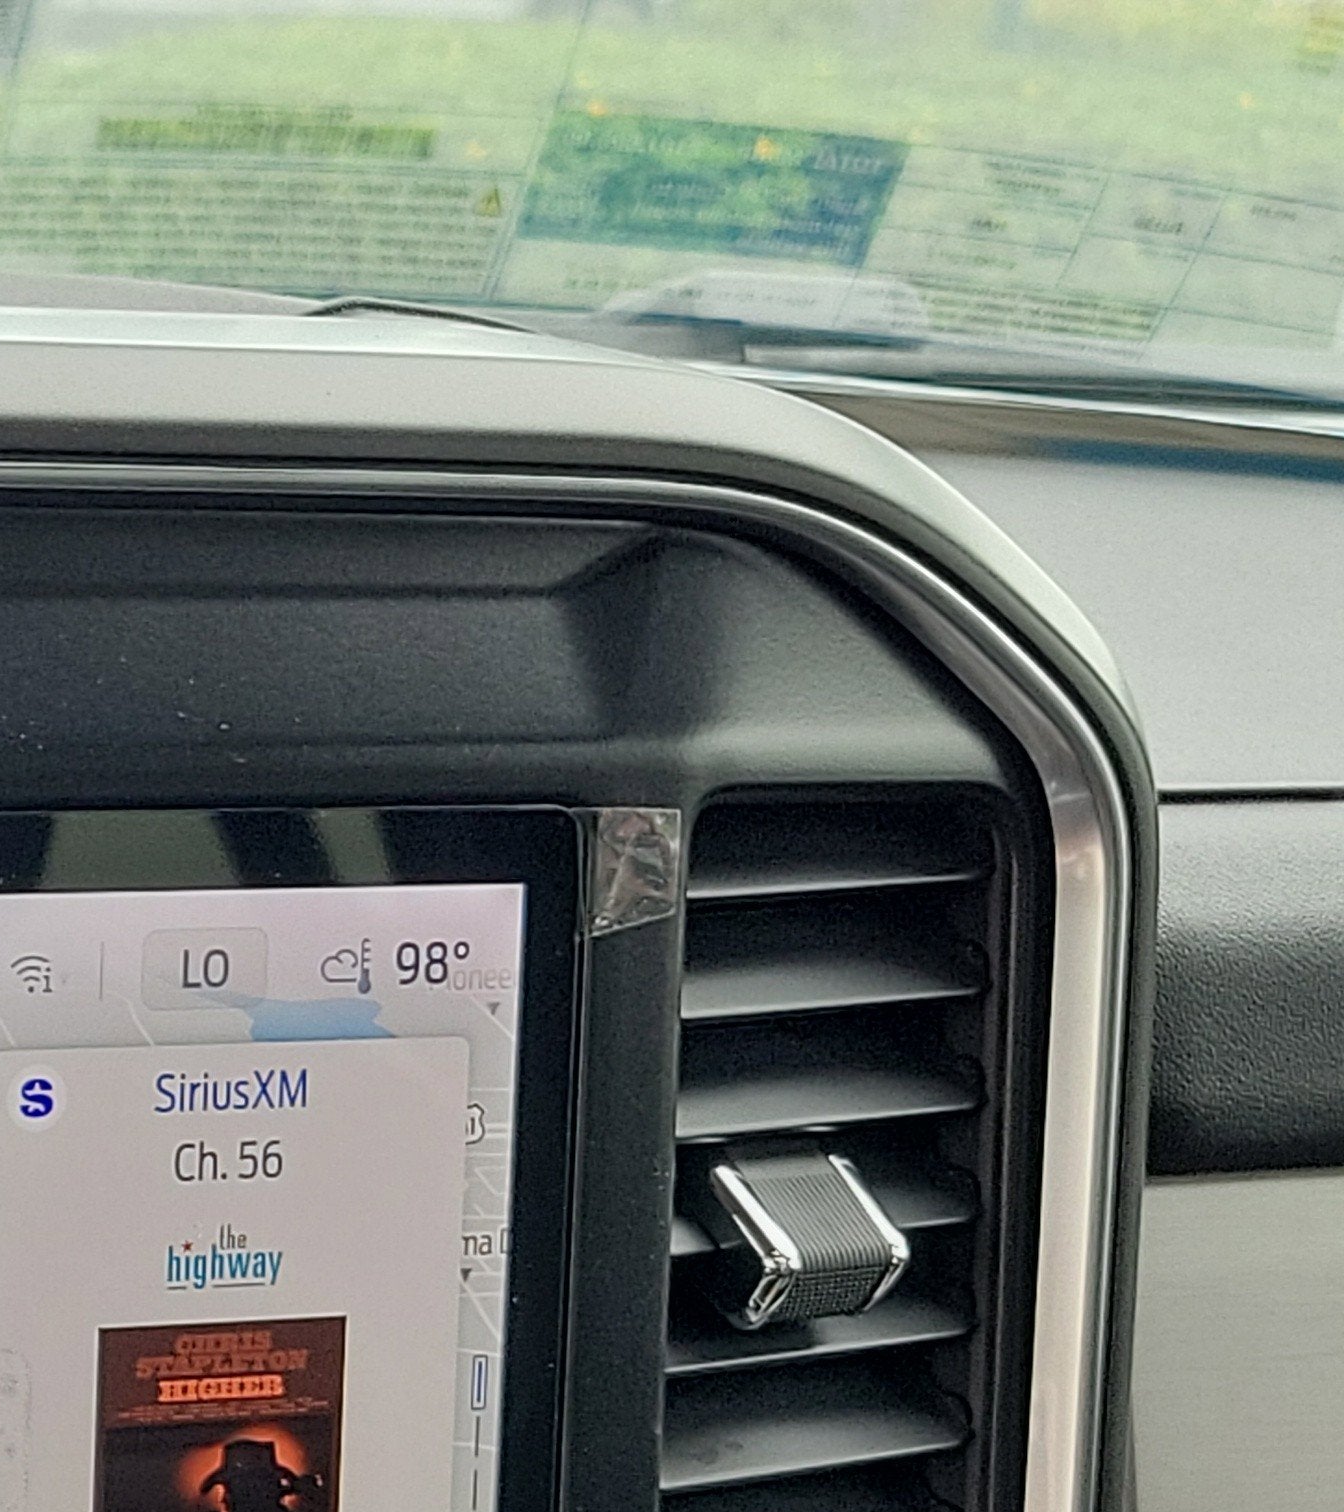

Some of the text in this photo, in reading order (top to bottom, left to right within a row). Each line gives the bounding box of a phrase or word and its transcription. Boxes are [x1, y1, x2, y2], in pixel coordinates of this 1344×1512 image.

[182, 949, 228, 989] LO
[154, 1068, 307, 1113] SiriusXM
[175, 1140, 283, 1181] Ch. 56
[219, 1223, 247, 1250] the
[167, 1244, 283, 1290] highway
